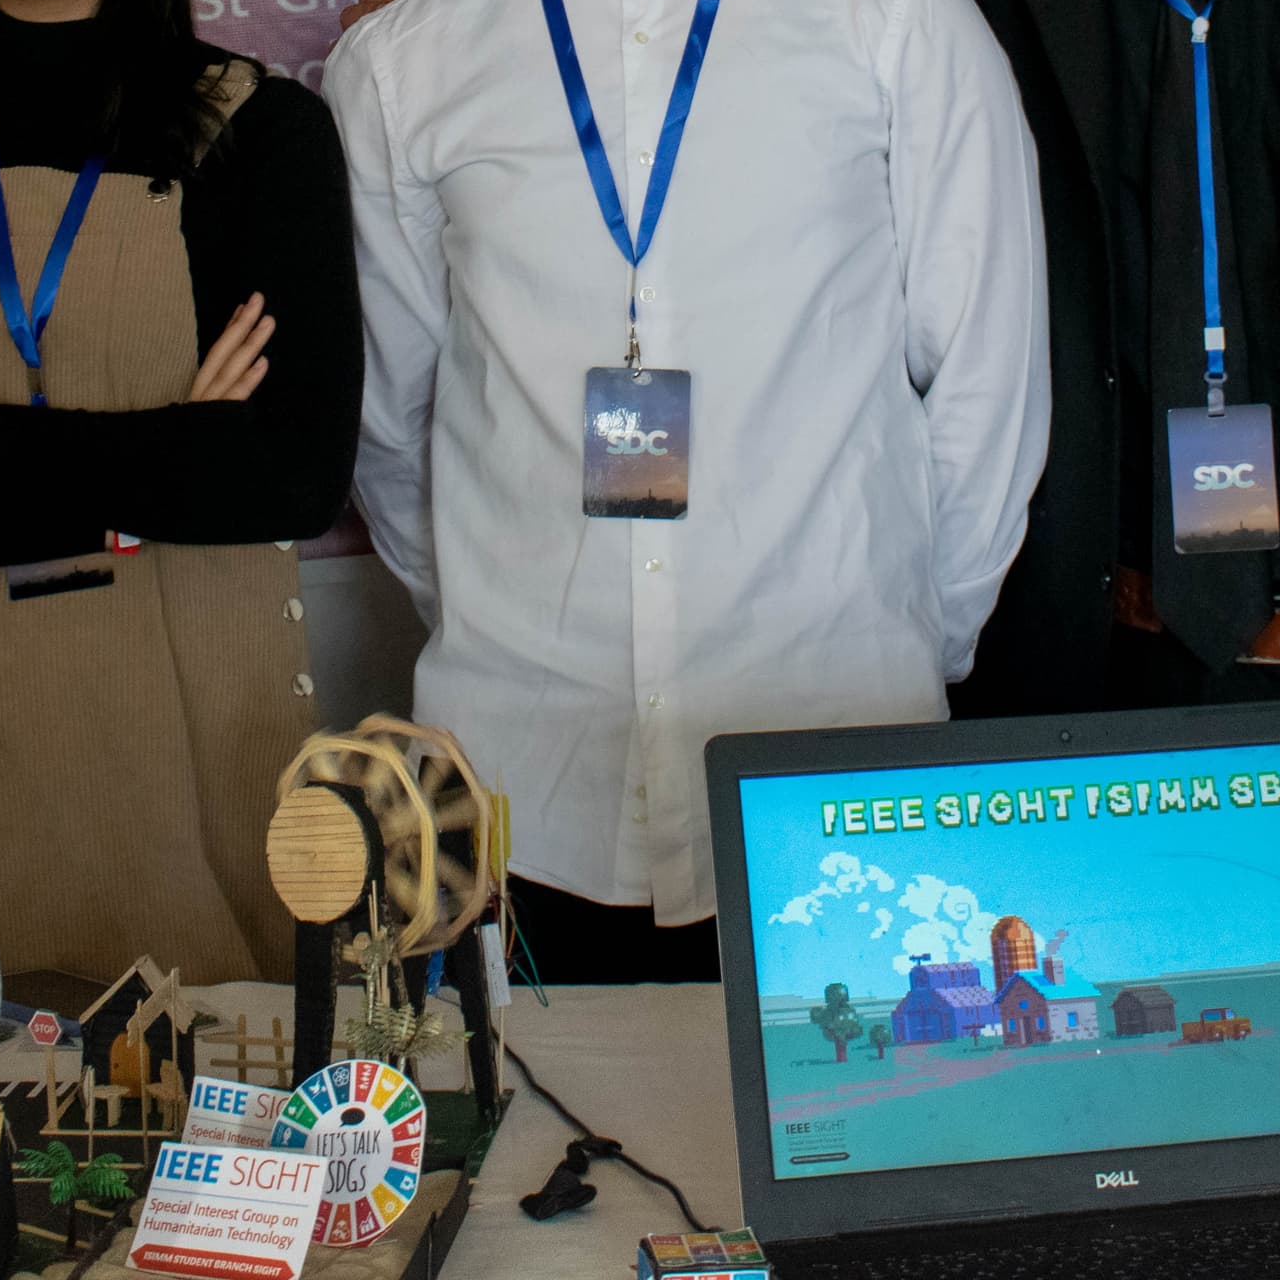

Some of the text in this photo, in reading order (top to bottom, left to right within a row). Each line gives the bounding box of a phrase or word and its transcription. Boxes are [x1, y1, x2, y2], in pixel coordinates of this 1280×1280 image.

[606, 430, 669, 455] SDC
[1194, 463, 1255, 491] SDC
[822, 795, 926, 836] IEEE
[933, 785, 1074, 828] SIGHT
[1085, 776, 1220, 818] ISIMM
[33, 1023, 56, 1034] STOP
[193, 1083, 248, 1115] IEEE
[190, 1124, 265, 1148] Special Interest
[785, 1119, 847, 1135] IEEE SIGHT
[352, 1130, 381, 1155] TALK
[155, 1148, 320, 1192] IEEE SIGHT
[1096, 1170, 1139, 1188] DELL
[149, 1198, 298, 1227] Special Interest Group on
[143, 1217, 295, 1250] Humanitarian Technology
[173, 1255, 214, 1268] STUDENT
[214, 1260, 253, 1273] BRANCH
[253, 1265, 281, 1277] SIGHT
